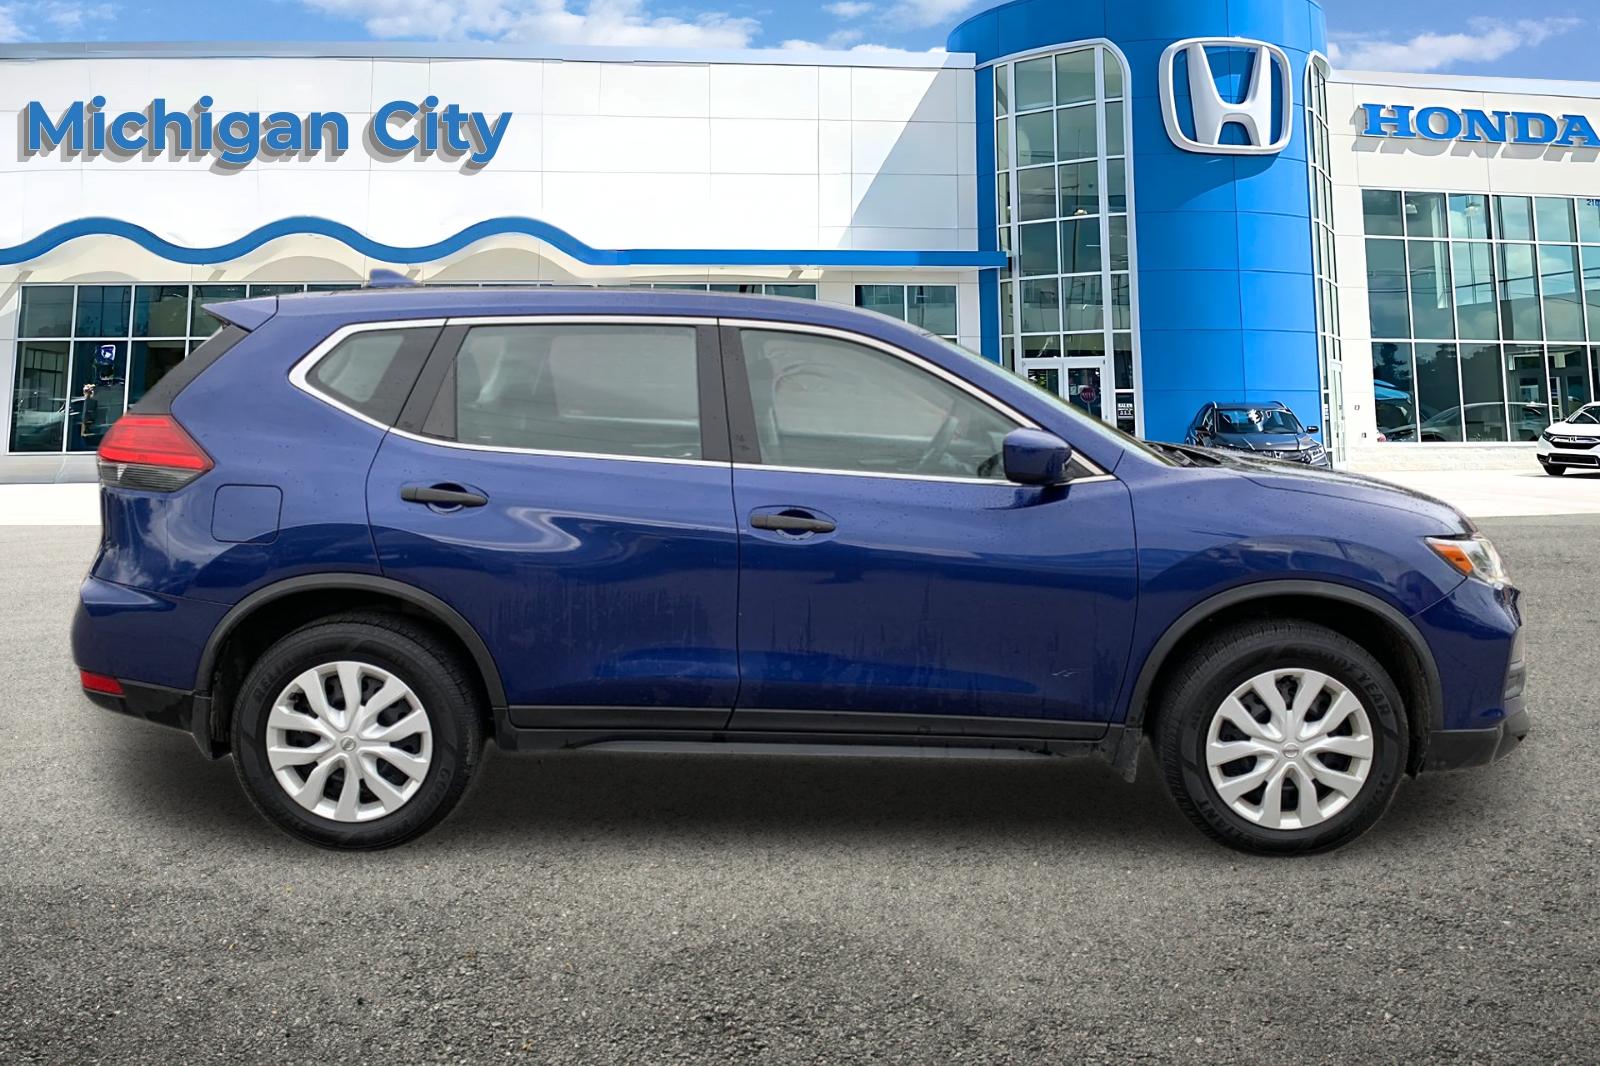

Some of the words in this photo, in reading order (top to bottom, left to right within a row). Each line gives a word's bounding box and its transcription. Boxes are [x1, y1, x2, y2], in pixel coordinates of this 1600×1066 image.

[28, 95, 350, 165] Michigan
[373, 95, 513, 164] City
[1360, 103, 1600, 148] HONDA
